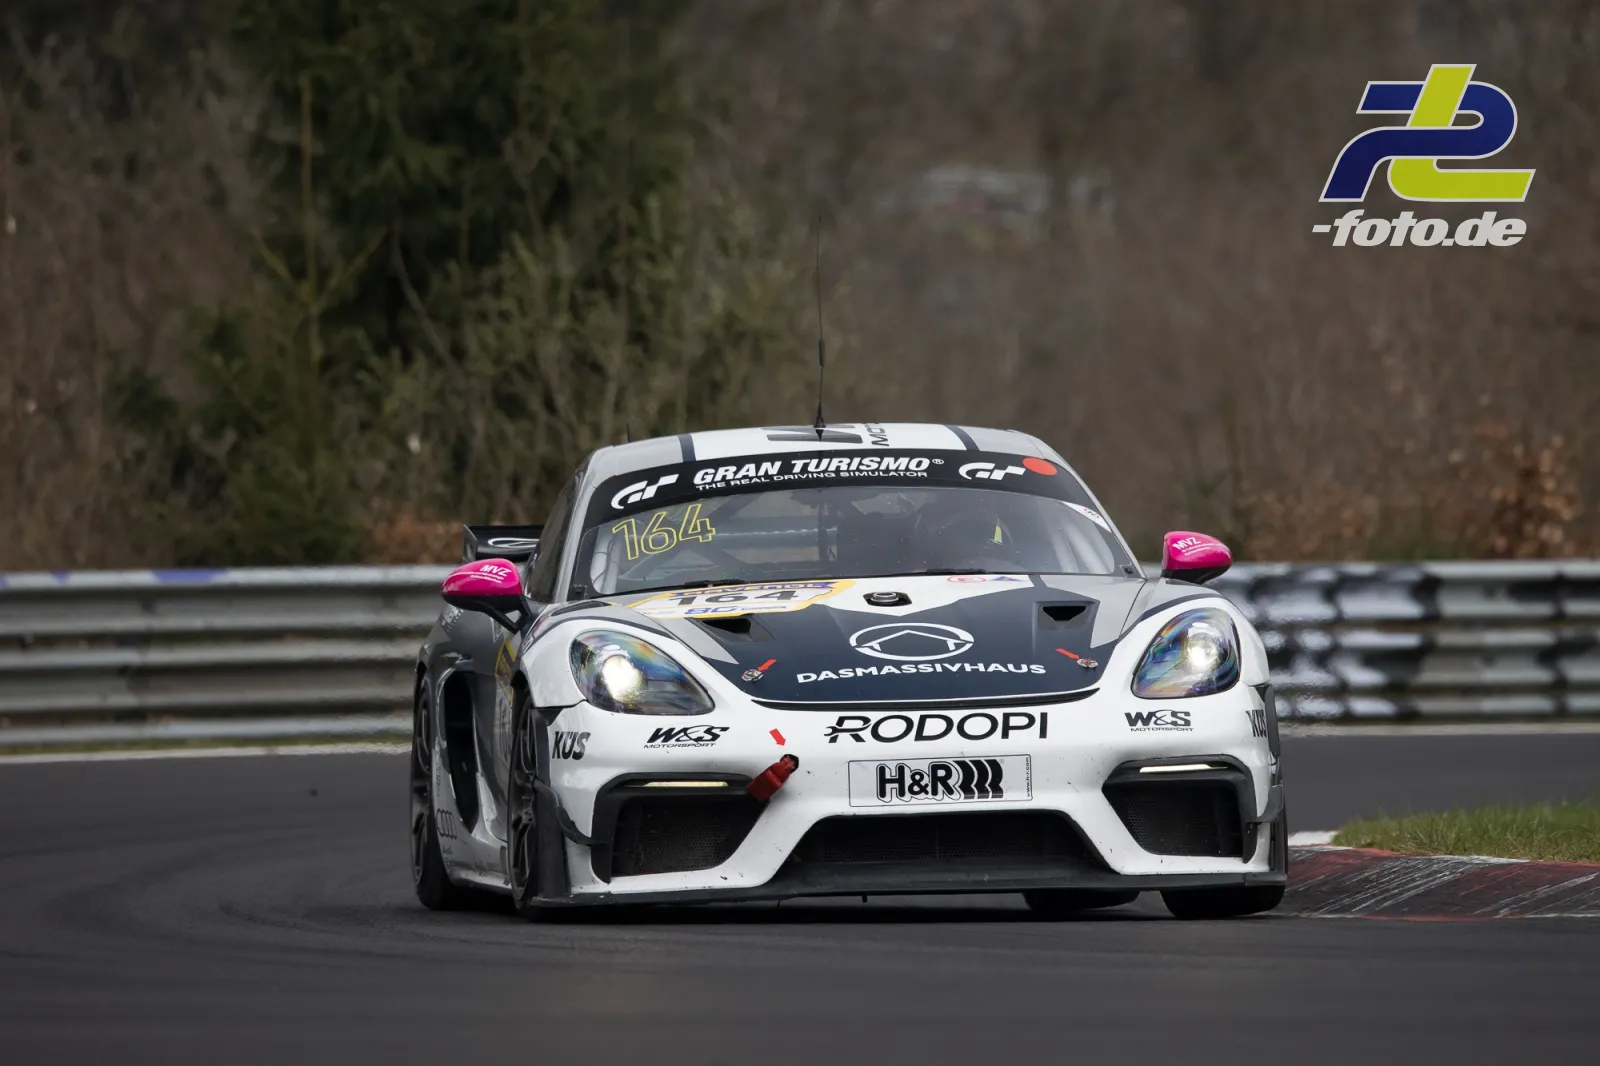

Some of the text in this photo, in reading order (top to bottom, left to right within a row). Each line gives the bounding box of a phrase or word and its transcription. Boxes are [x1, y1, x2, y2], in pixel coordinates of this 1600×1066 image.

[693, 461, 782, 485] GRAN
[696, 481, 726, 491] THE
[730, 476, 770, 486] REAL
[773, 471, 836, 481] DRIVING
[612, 503, 716, 561] 164
[1172, 537, 1201, 550] MVZ
[480, 564, 512, 577] MVZ
[668, 590, 799, 606] 164
[796, 662, 1047, 684] DASMASSIVHAUS
[824, 711, 1048, 744] RODOPI
[1125, 709, 1191, 727] W&S
[647, 725, 730, 743] W&S
